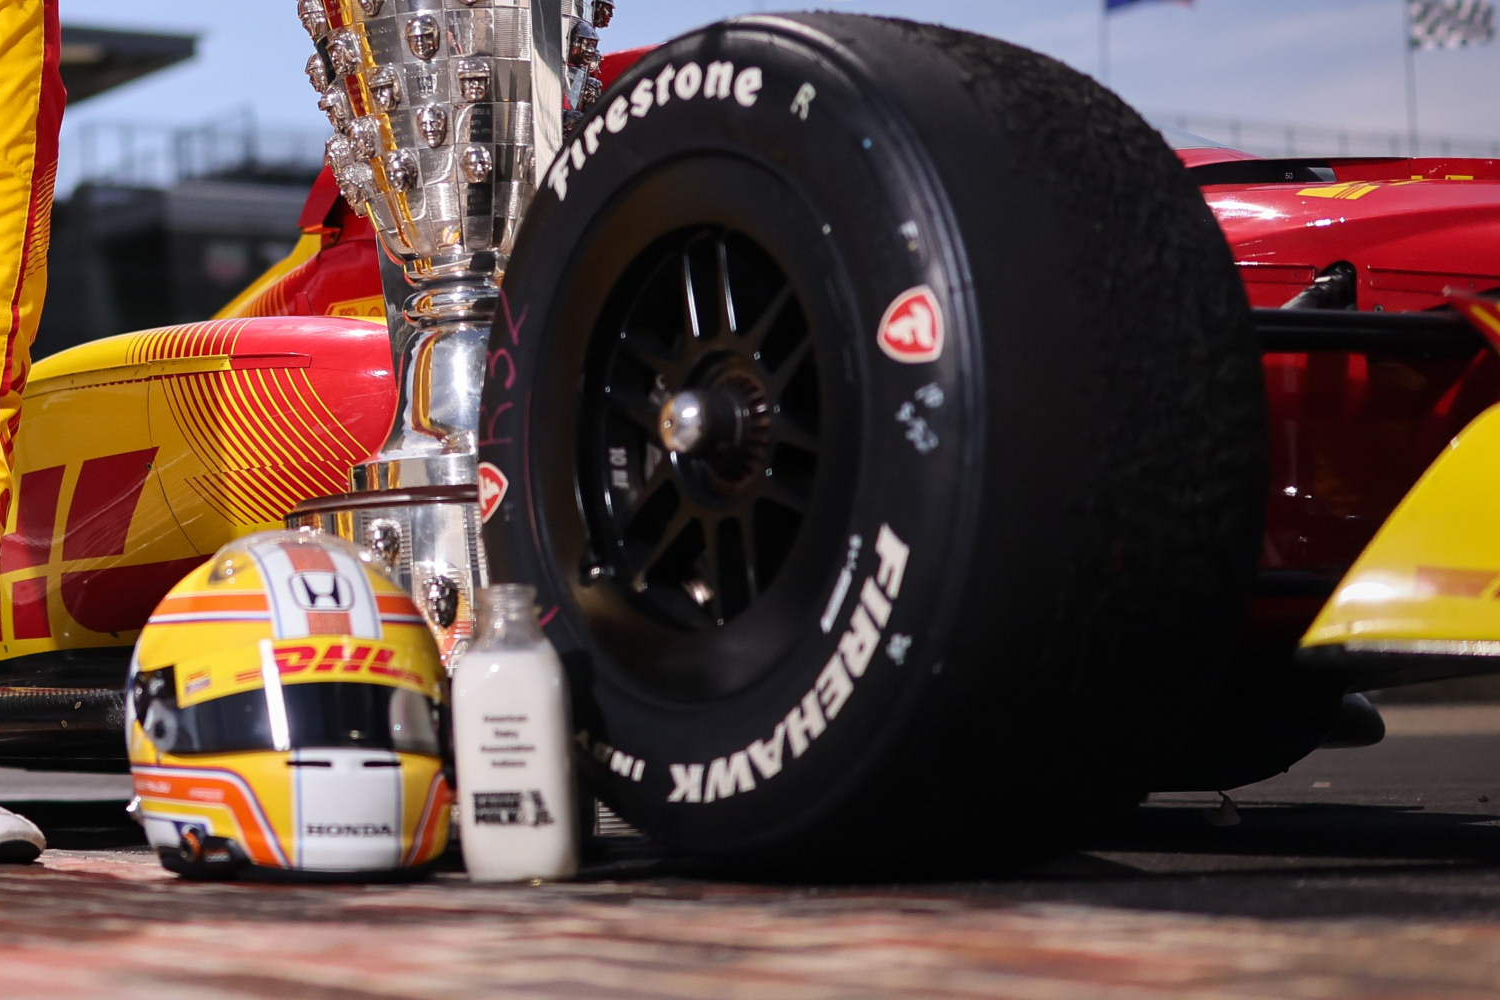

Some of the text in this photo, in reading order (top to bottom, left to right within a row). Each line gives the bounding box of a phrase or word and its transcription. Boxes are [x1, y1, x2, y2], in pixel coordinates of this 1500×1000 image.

[548, 60, 763, 202] Firestone
[1285, 172, 1294, 180] 50
[272, 645, 408, 681] DHL
[667, 521, 911, 804] FIREHAWK
[306, 821, 395, 838] HONDA
